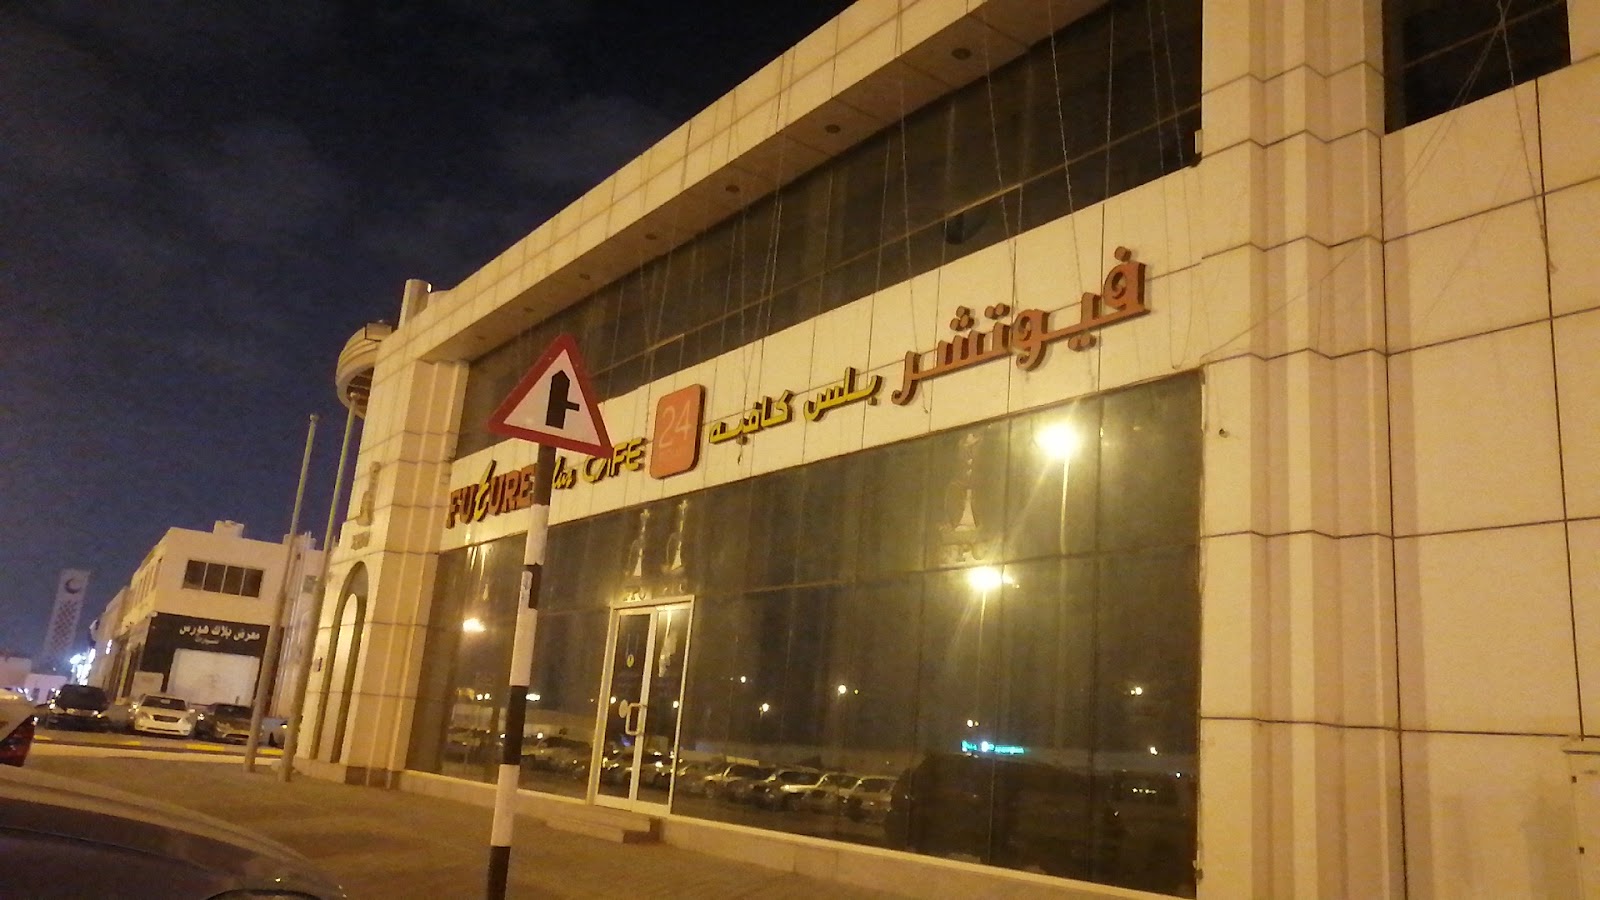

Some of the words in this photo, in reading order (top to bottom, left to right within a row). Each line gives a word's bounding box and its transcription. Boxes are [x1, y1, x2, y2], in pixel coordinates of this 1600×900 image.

[892, 246, 1151, 406] فيوتشر
[708, 390, 794, 445] كافيه
[803, 366, 882, 421] بلس
[659, 400, 691, 448] 24
